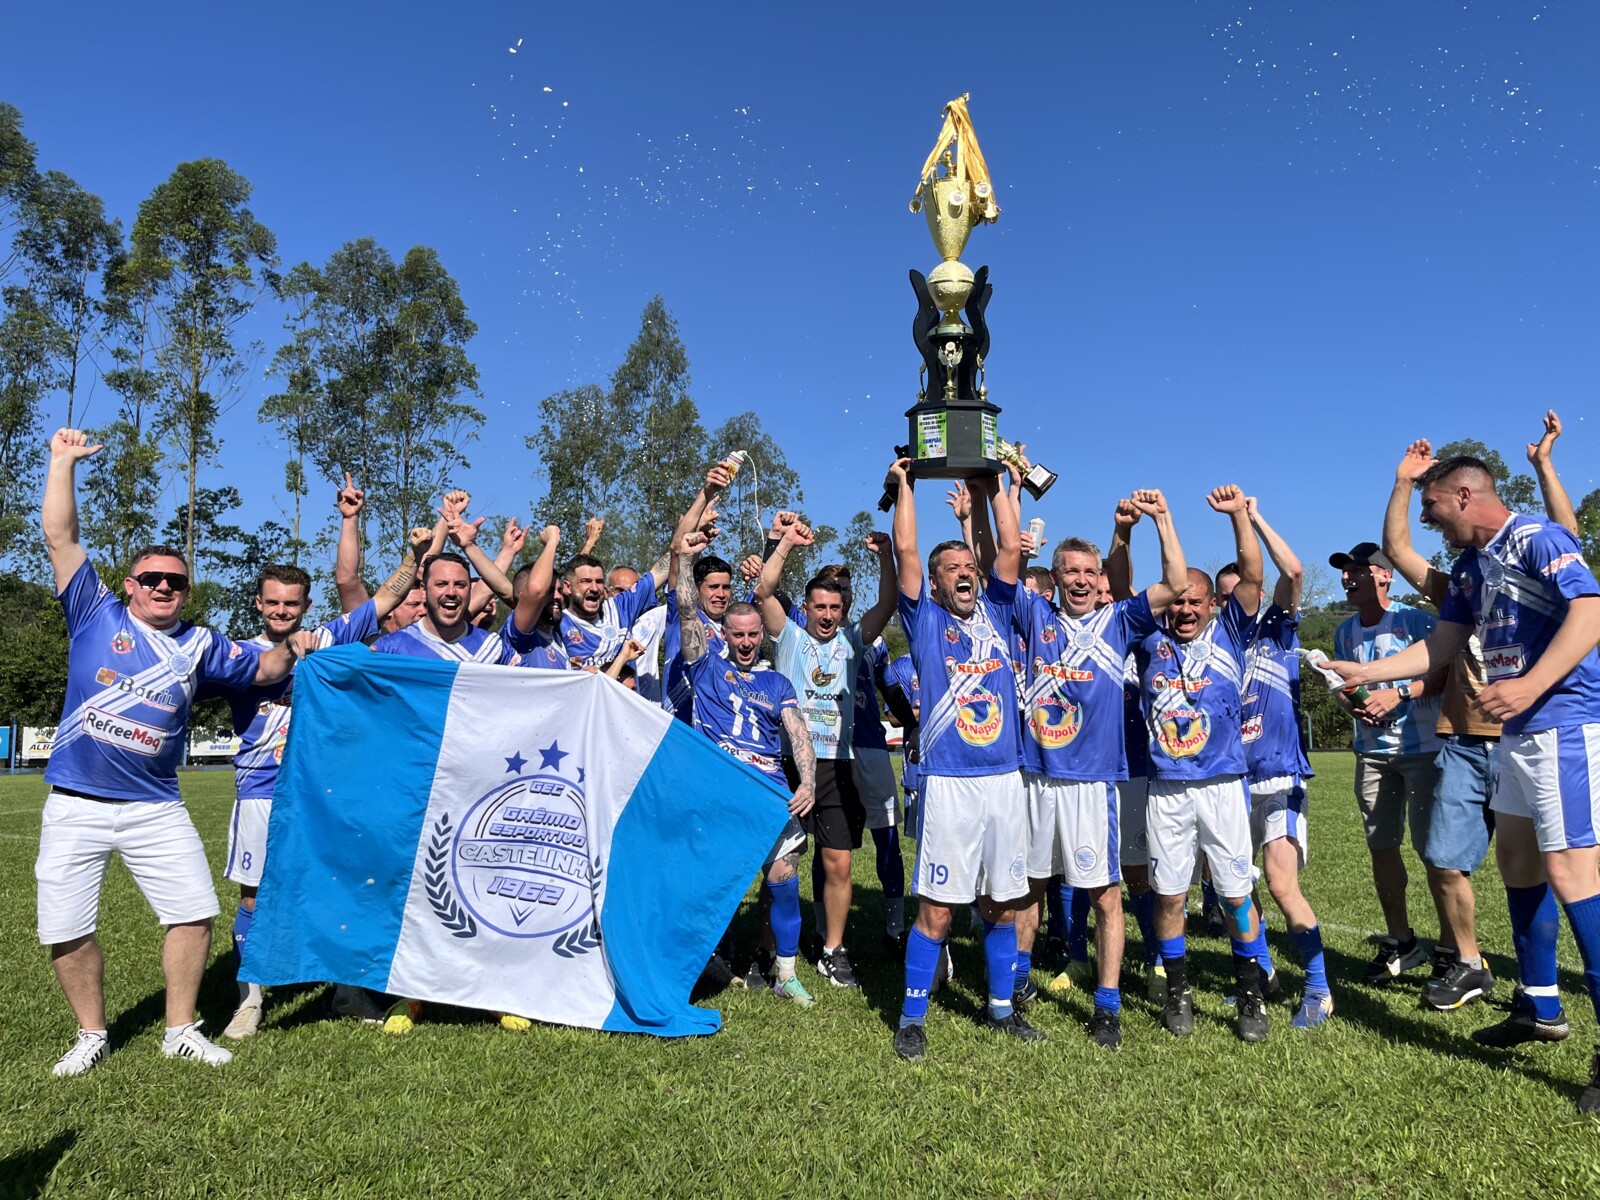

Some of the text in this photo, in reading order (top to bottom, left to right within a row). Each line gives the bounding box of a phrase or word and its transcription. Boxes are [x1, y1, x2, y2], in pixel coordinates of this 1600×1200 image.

[1042, 665, 1094, 681] REALEZA
[86, 711, 160, 752] RefreeMaq
[1039, 722, 1079, 740] Napoli
[530, 781, 565, 796] GEC
[502, 806, 582, 831] GRÊMIO
[489, 823, 587, 848] ESPORTIVO
[242, 851, 252, 871] 8
[929, 862, 949, 886] 19
[487, 876, 566, 906] 1962
